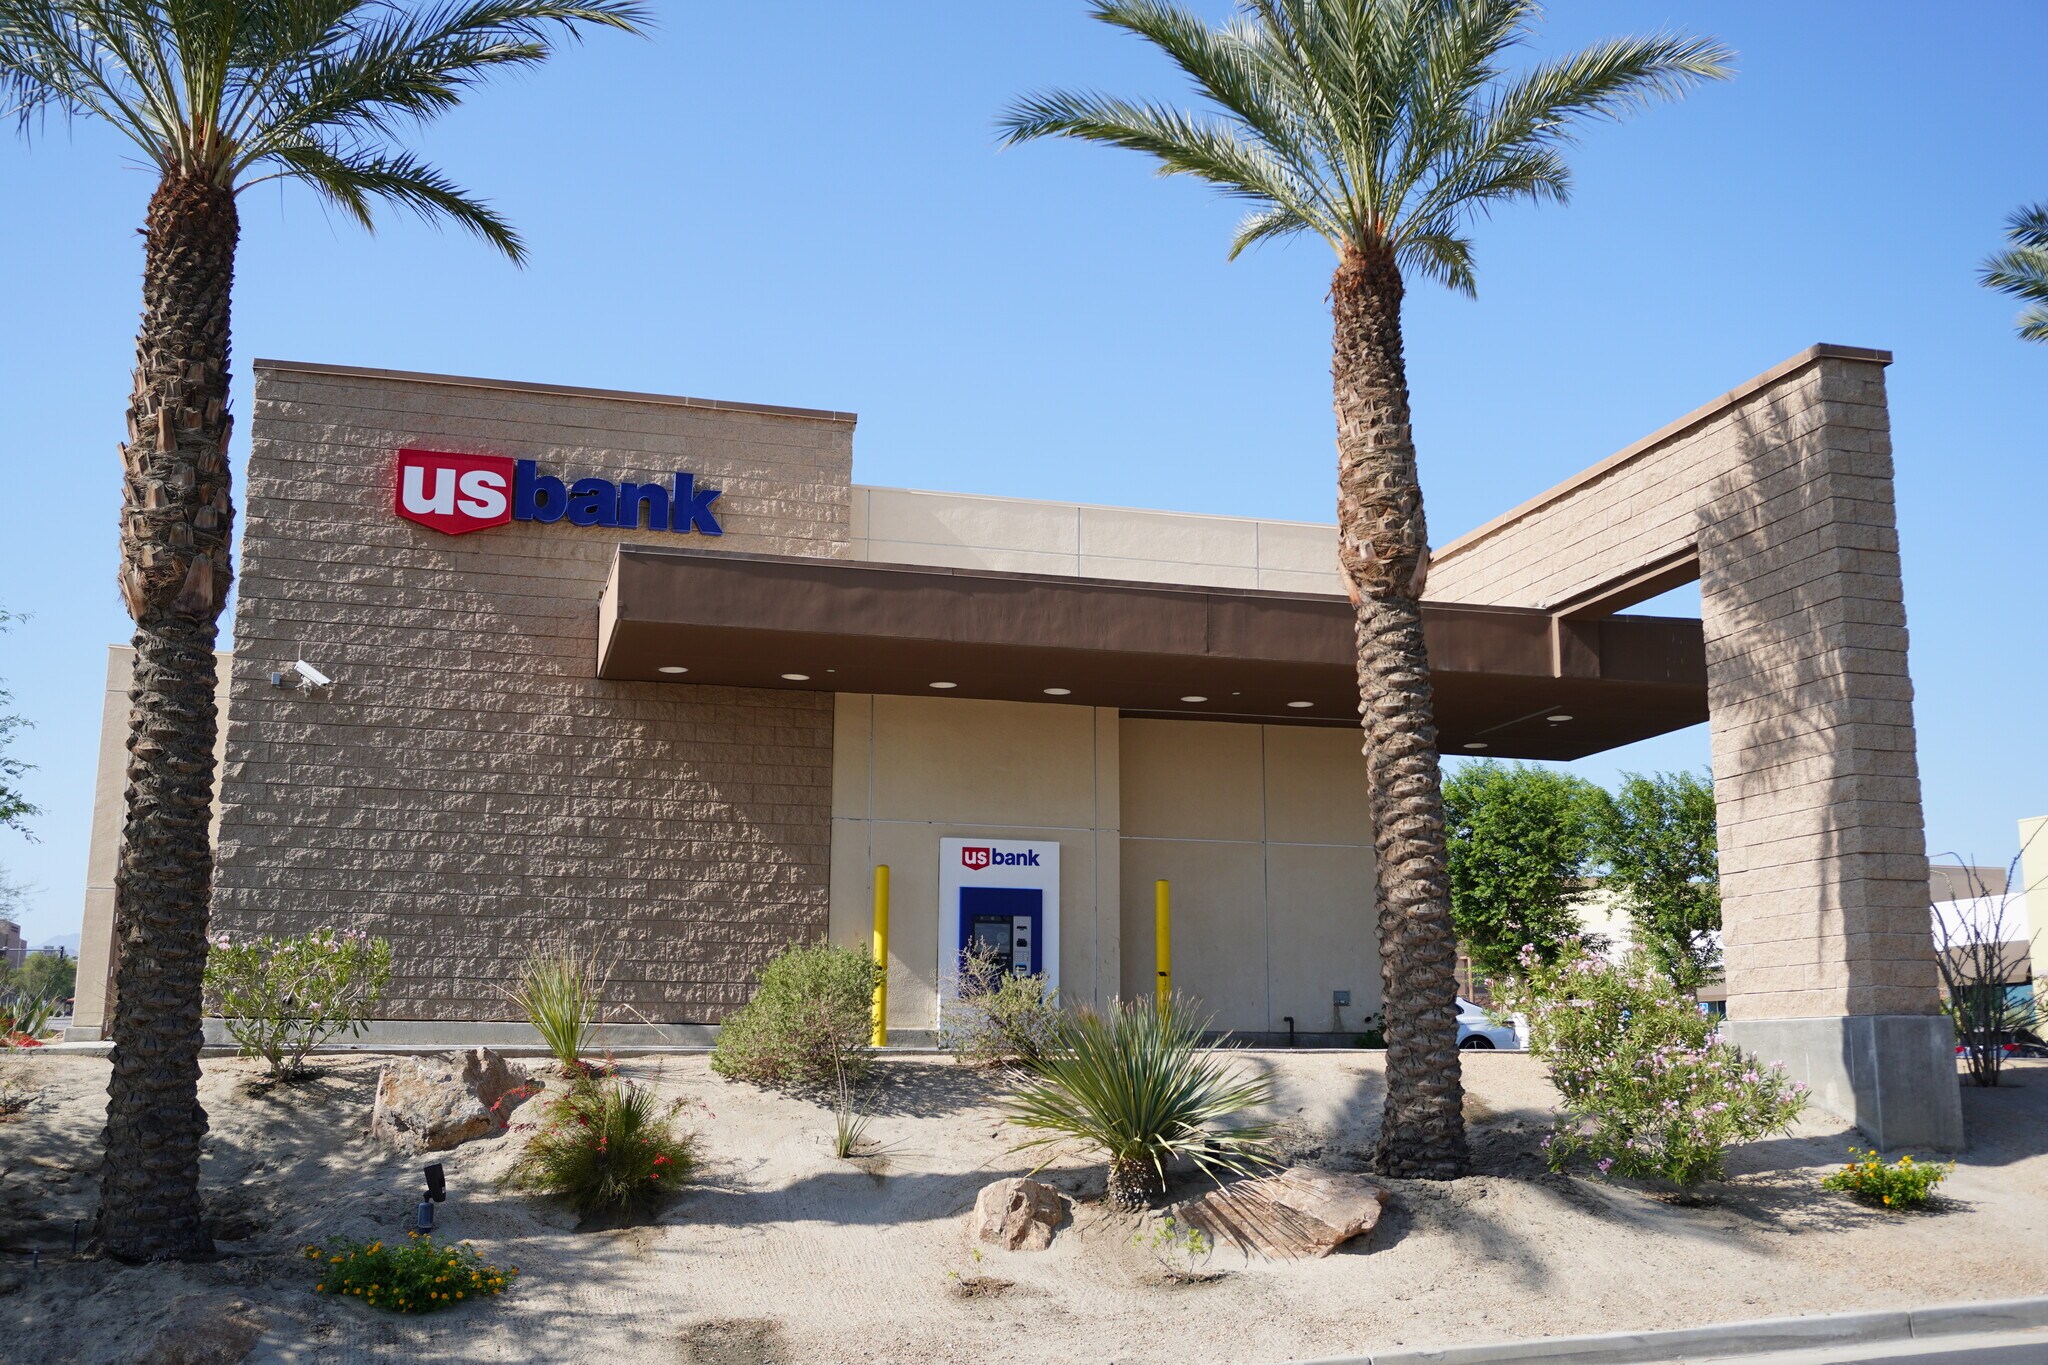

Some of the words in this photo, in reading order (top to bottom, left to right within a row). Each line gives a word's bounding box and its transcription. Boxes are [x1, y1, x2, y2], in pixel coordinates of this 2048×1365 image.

[402, 465, 507, 519] us
[514, 458, 723, 536] bank
[964, 851, 987, 865] us
[992, 847, 1040, 867] bank
